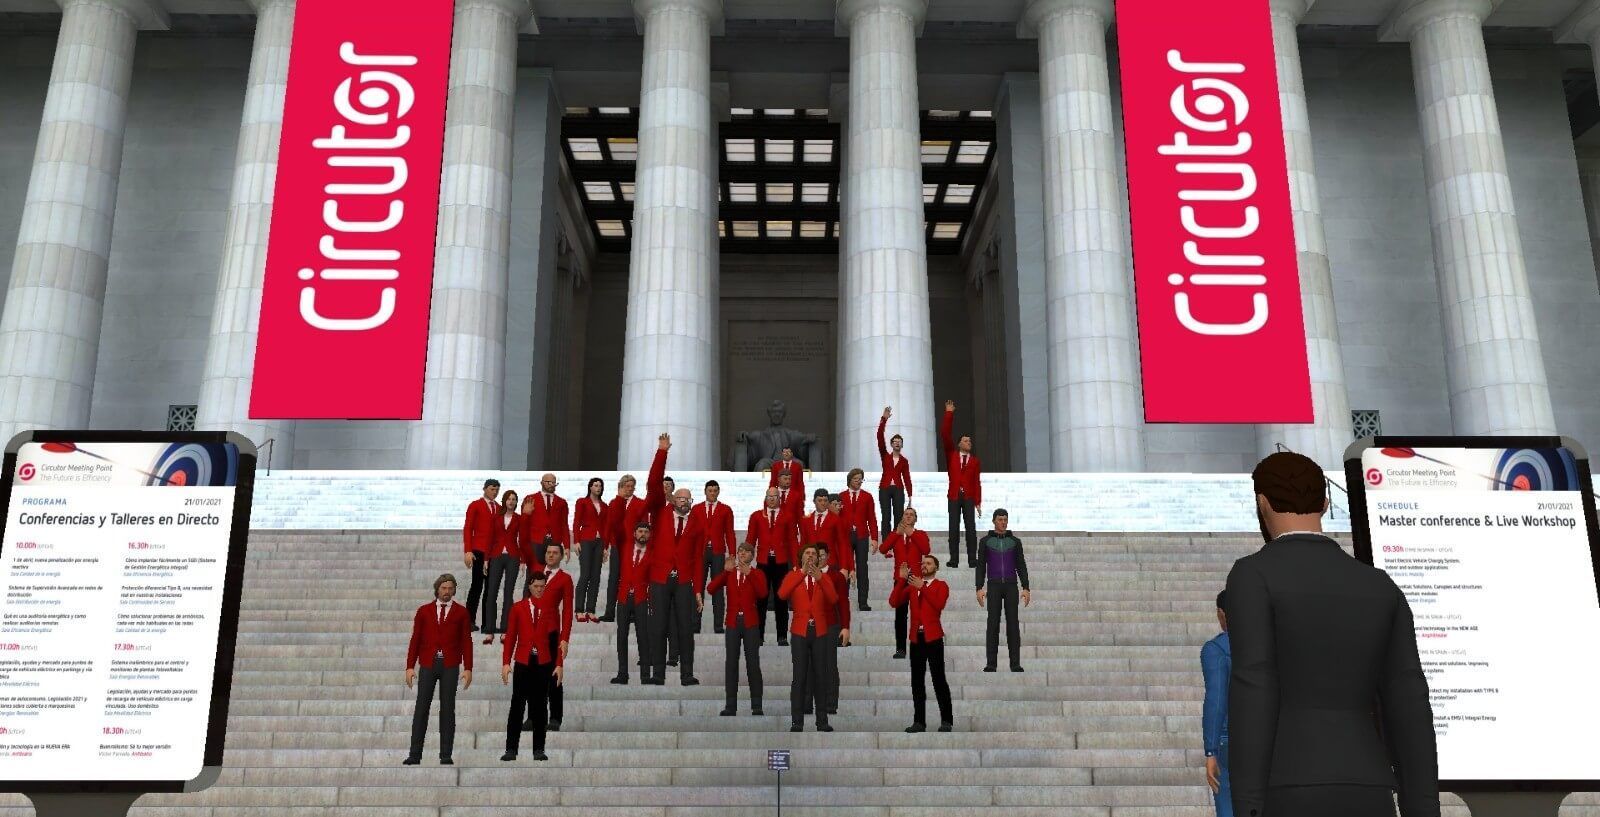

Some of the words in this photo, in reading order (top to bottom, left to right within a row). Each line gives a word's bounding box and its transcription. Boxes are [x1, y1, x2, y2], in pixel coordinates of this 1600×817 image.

[297, 41, 418, 331] Circutor
[1157, 49, 1269, 335] Circutor
[68, 464, 94, 473] Meeting
[1413, 469, 1438, 478] Meeting
[82, 474, 111, 482] Efficiency
[1430, 479, 1457, 487] Efficiency
[19, 513, 95, 525] Conferencias
[98, 516, 106, 528] y
[111, 513, 154, 525] Talleres
[159, 516, 173, 525] en
[177, 513, 219, 525] Directo
[1379, 515, 1416, 526] Master
[1421, 515, 1480, 526] conference
[1485, 515, 1493, 526] &
[1497, 515, 1519, 526] Live
[1522, 515, 1576, 530] Workshop
